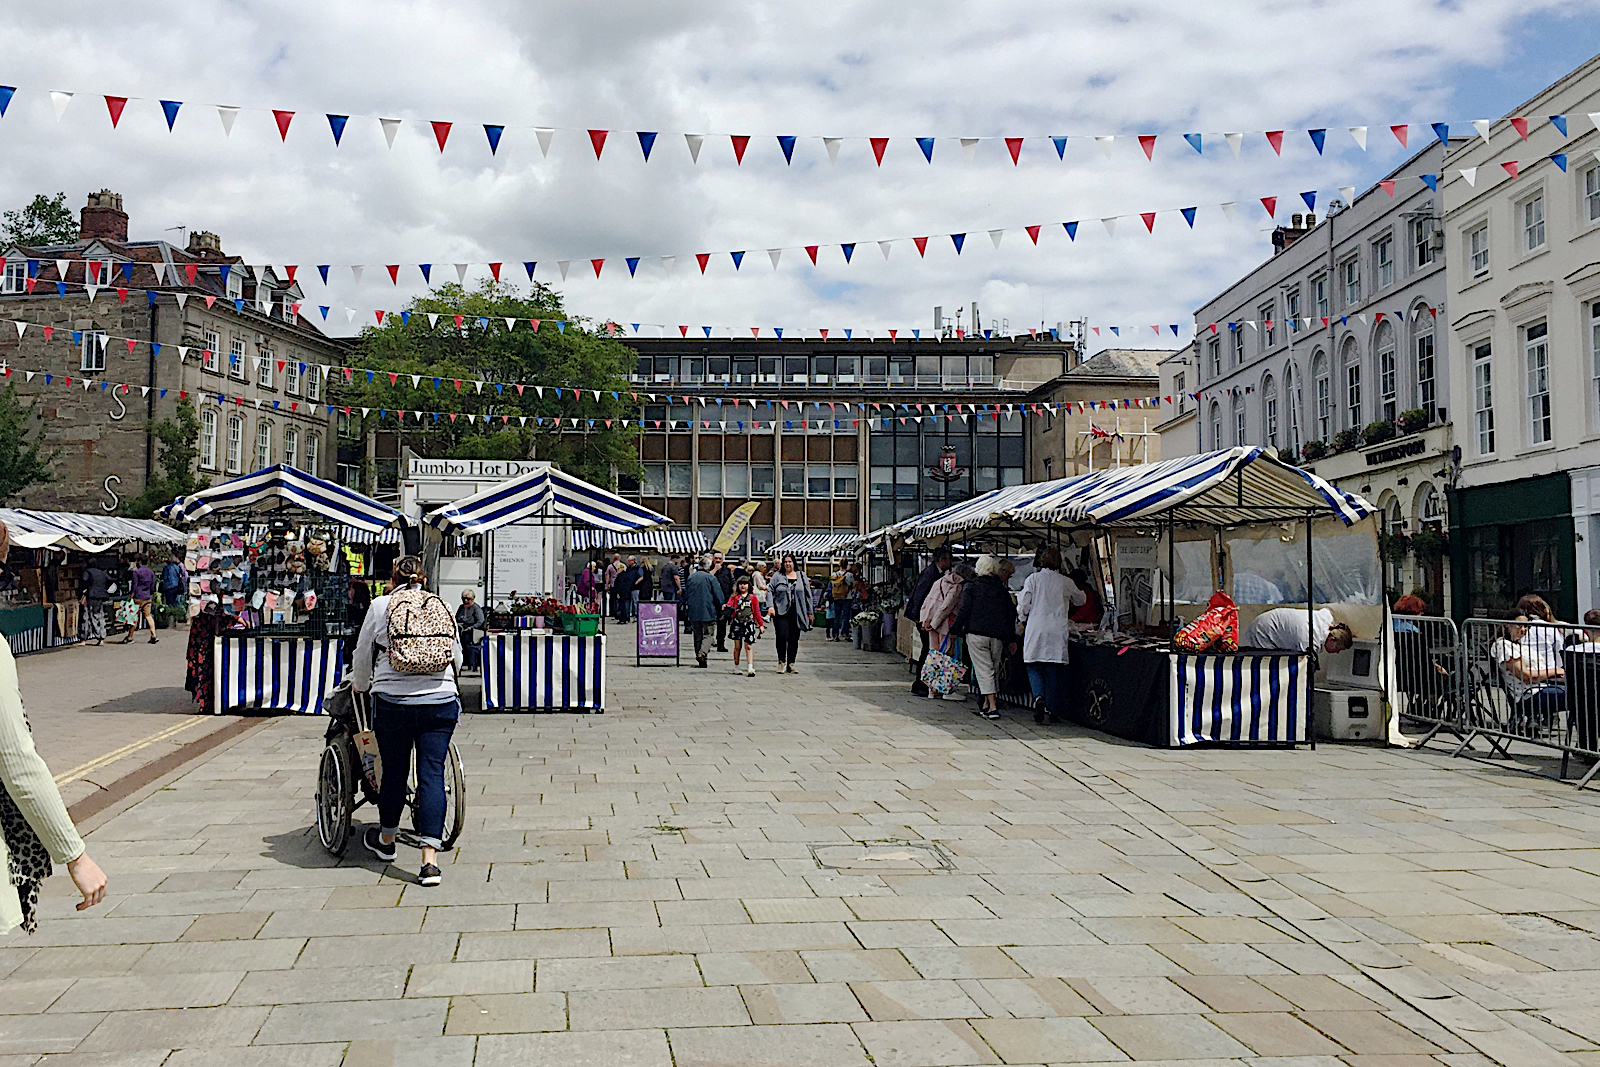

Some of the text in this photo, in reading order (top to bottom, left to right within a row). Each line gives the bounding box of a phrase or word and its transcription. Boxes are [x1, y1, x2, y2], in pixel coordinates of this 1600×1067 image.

[411, 460, 541, 475] Jumbo Hot Do
